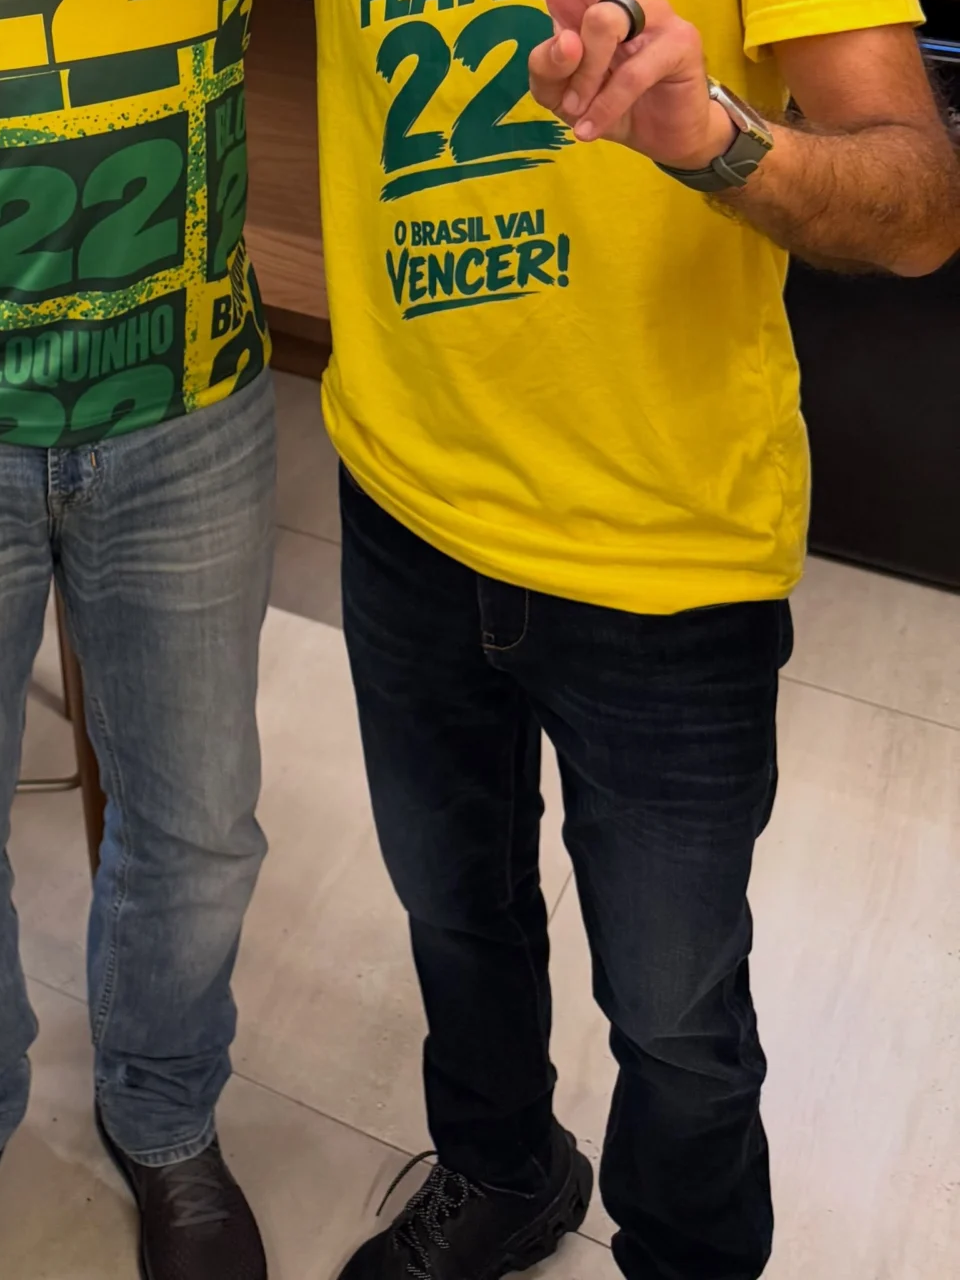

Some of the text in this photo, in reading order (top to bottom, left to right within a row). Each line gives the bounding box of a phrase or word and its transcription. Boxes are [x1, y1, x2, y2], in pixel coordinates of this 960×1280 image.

[375, 5, 578, 174] 22
[395, 209, 545, 247] O BRASIL VAI
[386, 233, 570, 306] VENCER!
